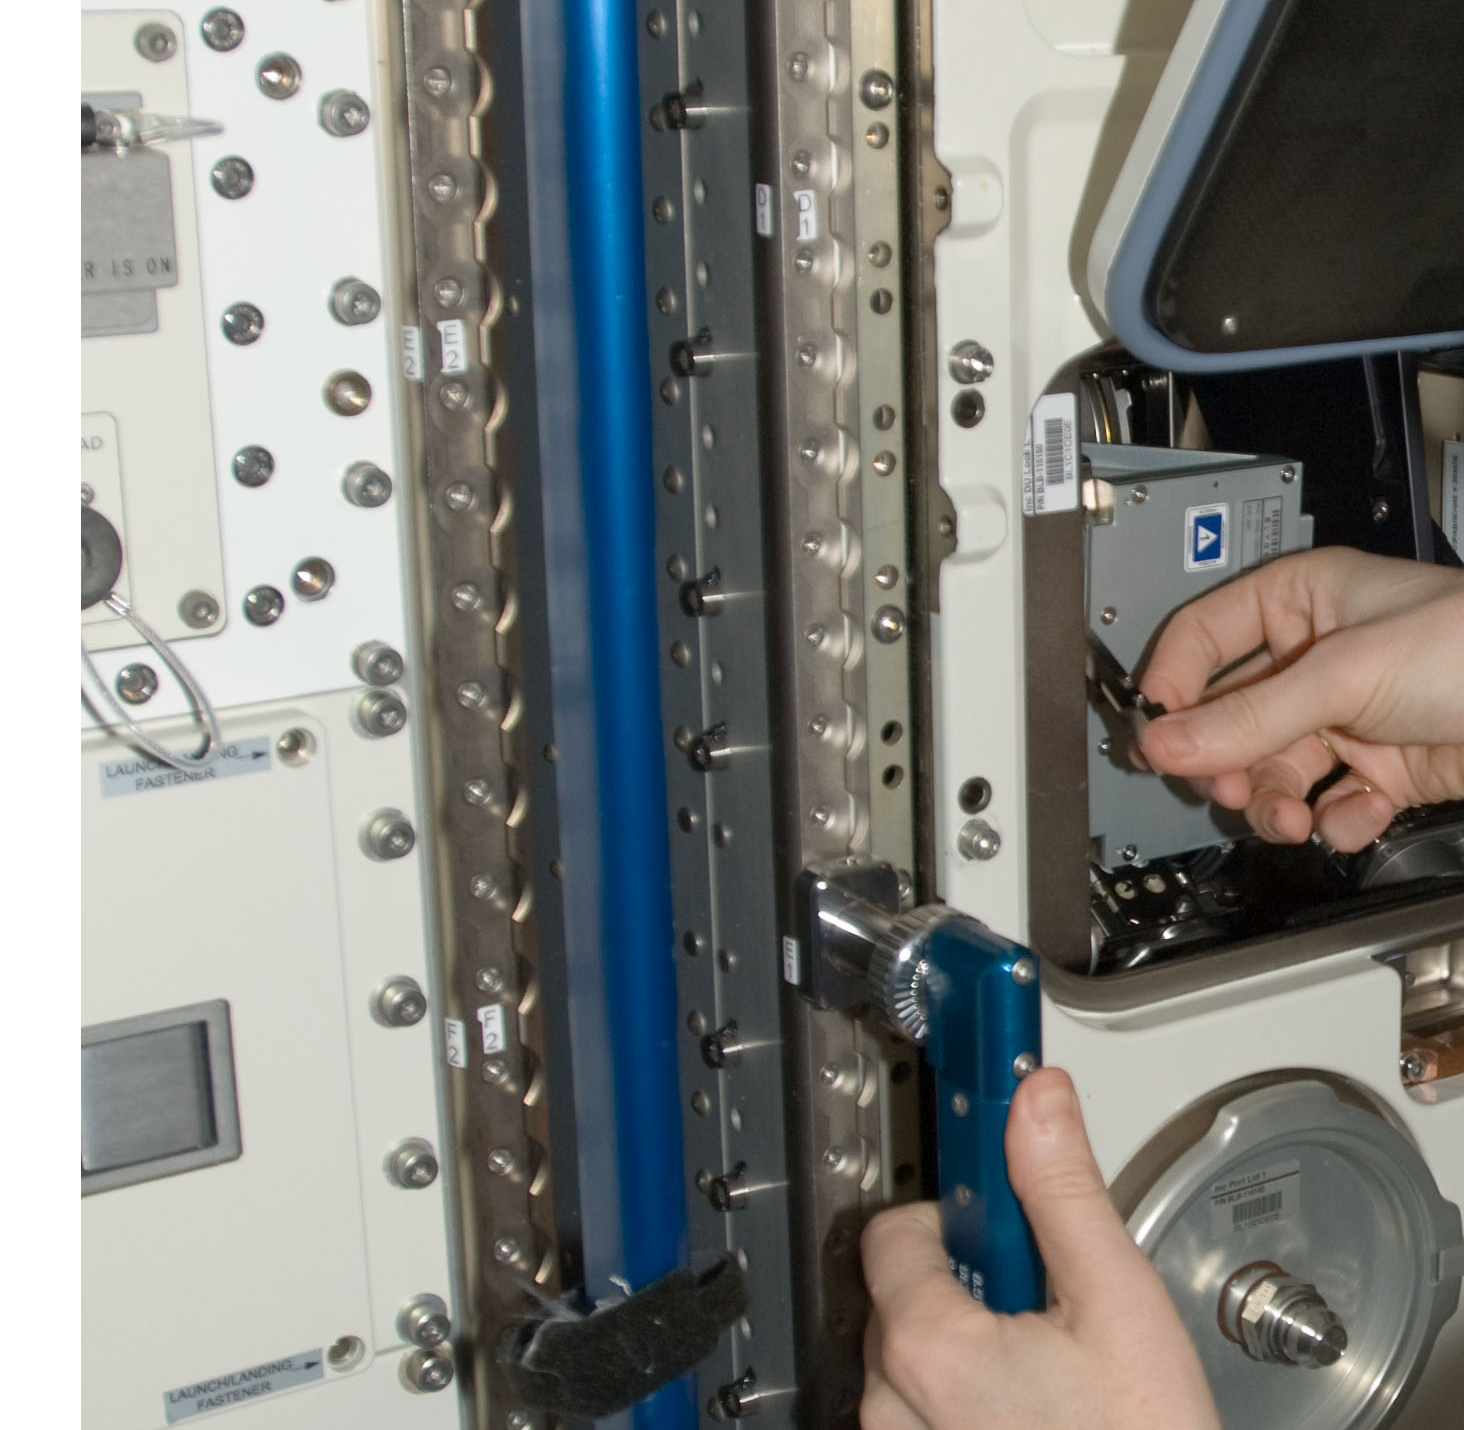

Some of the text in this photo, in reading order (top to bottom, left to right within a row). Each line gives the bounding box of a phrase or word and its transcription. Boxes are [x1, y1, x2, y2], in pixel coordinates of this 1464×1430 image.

[111, 258, 135, 277] IS
[146, 256, 170, 274] ON
[135, 767, 217, 791] FASTENER
[169, 1359, 293, 1404] LAUNCH/LANDING
[197, 1381, 272, 1412] FASTENER
